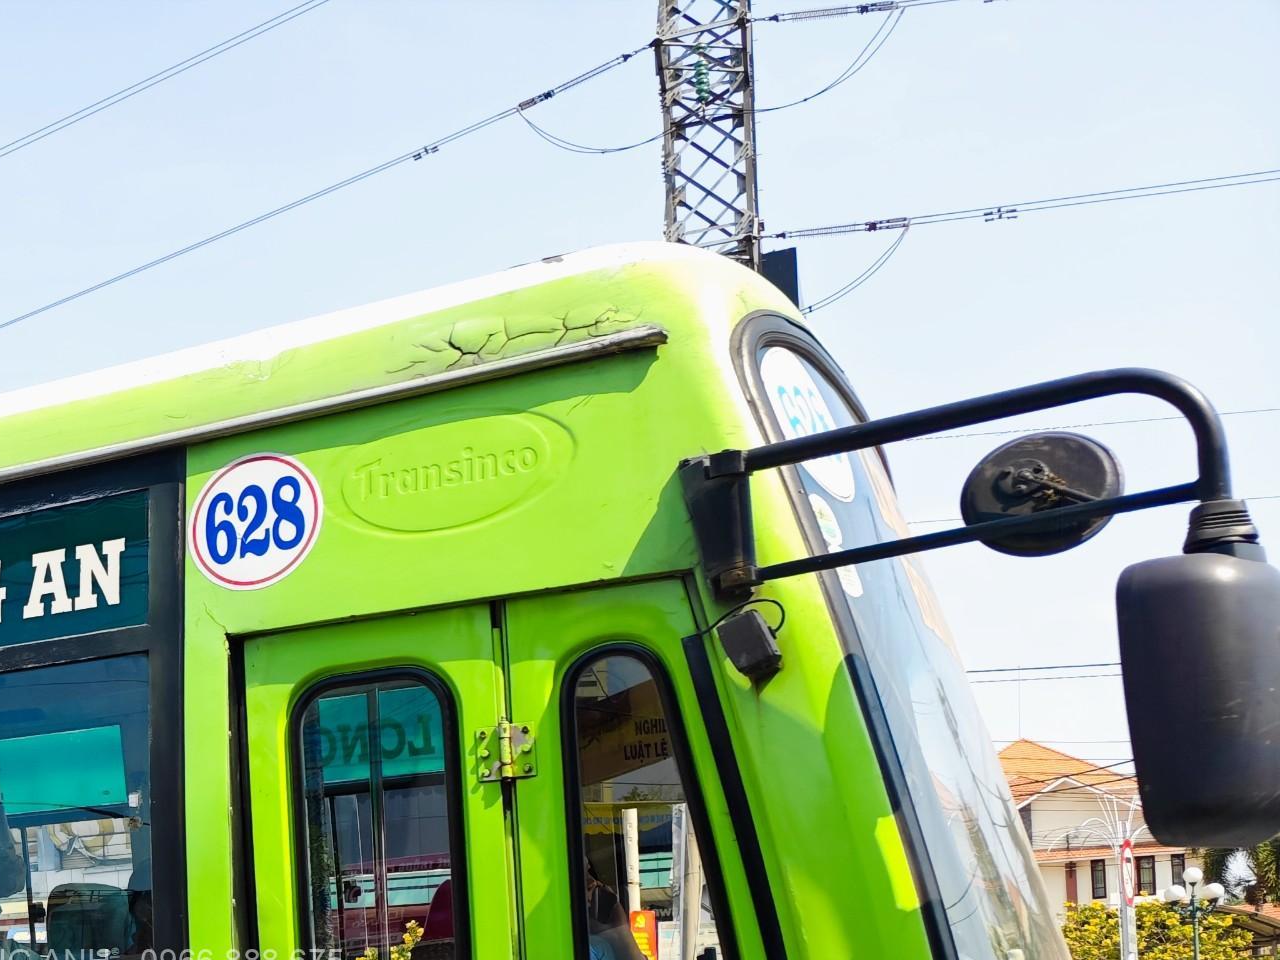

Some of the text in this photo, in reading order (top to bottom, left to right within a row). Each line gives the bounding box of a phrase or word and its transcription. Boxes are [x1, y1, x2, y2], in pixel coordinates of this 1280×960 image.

[352, 446, 539, 501] Transinco
[205, 475, 305, 565] 628
[23, 537, 126, 619] AN
